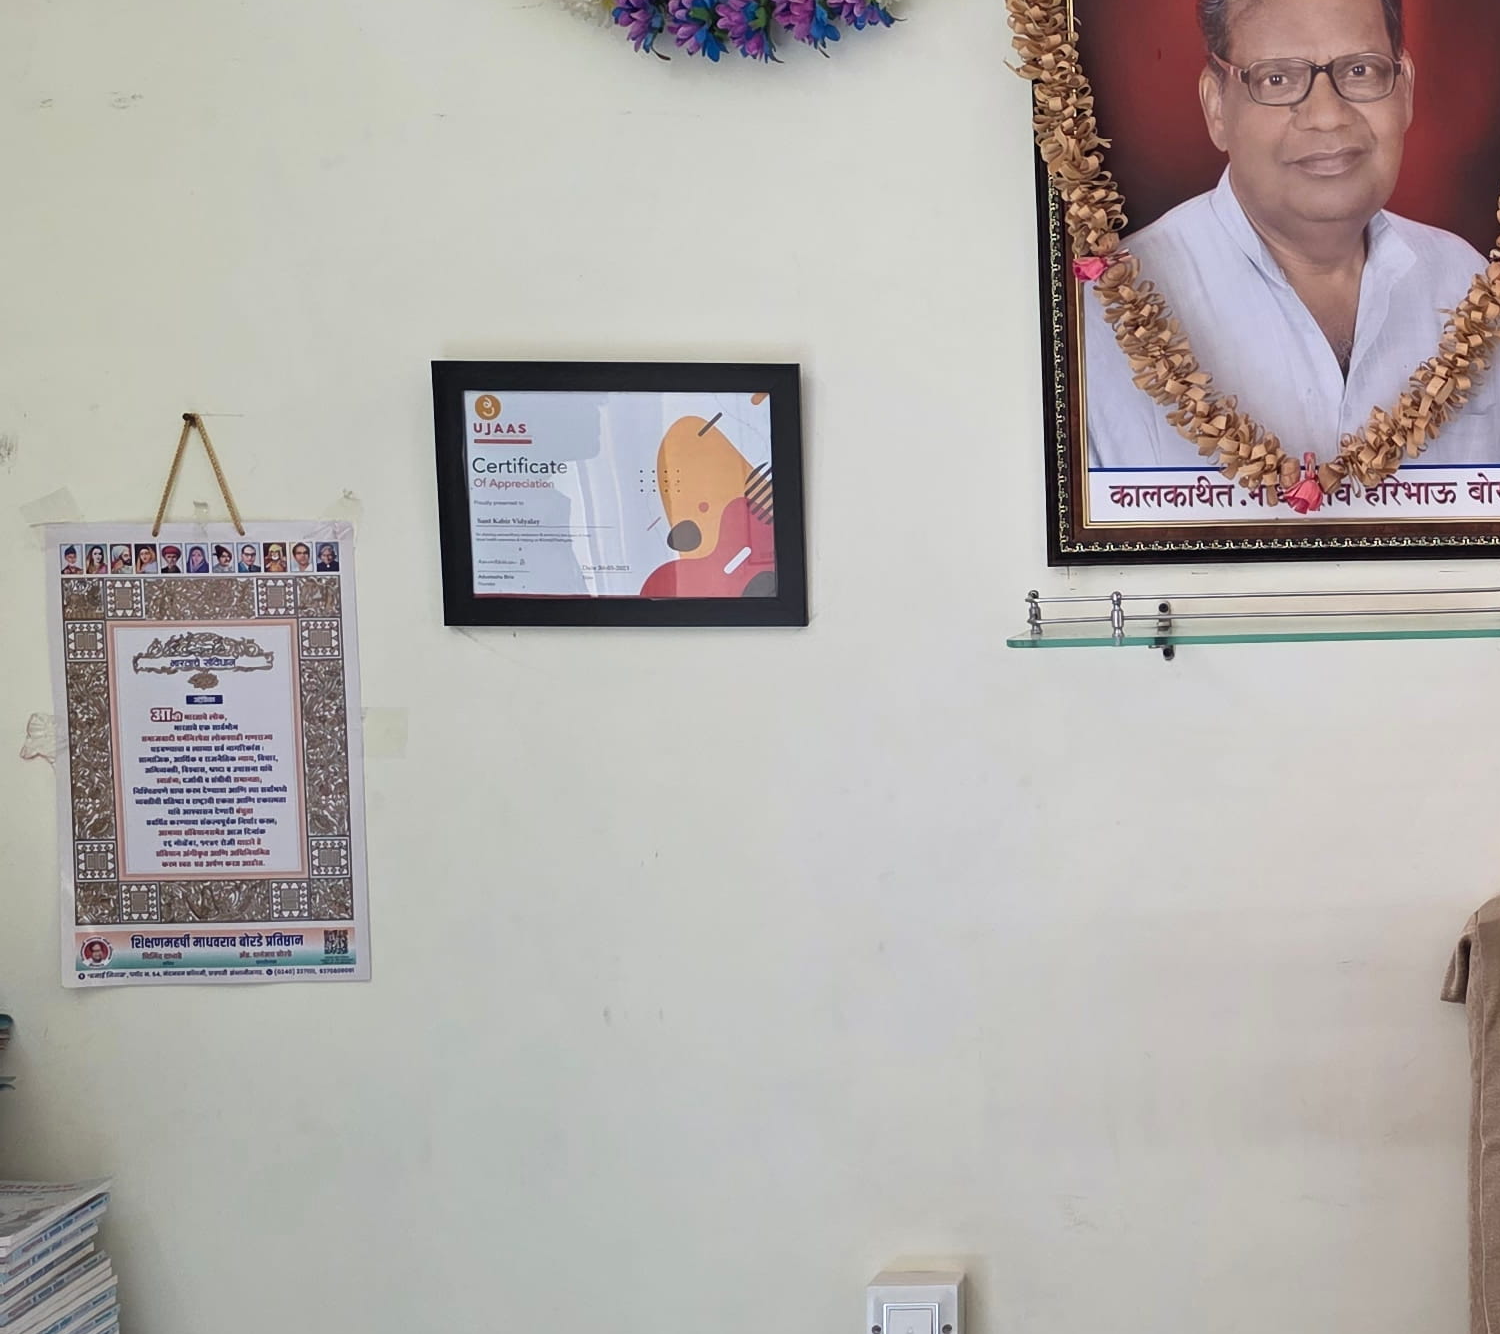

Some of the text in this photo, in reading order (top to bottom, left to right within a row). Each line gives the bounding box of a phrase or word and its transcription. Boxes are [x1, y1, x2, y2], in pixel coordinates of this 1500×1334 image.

[473, 422, 527, 435] UJAAS
[472, 457, 568, 474] Certificate
[474, 478, 555, 490] Of Appreciation
[512, 518, 541, 527] Vidyalay
[131, 932, 303, 949] शिक्षणमहर्षी माधवराव बोरडे प्रतिष्ठान
